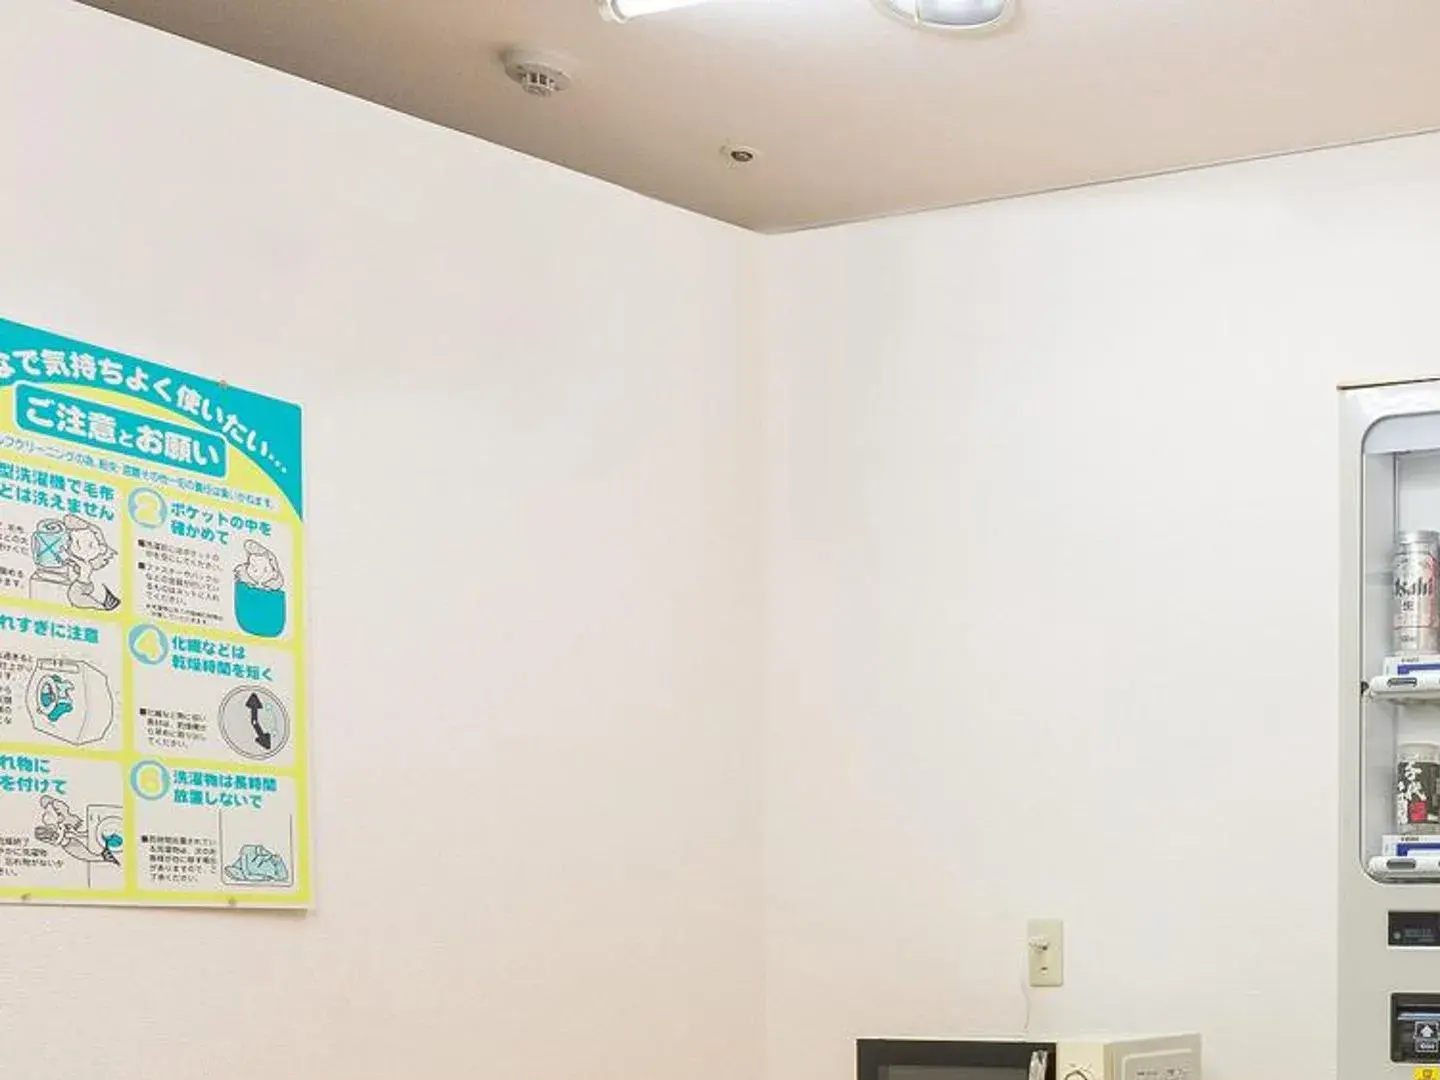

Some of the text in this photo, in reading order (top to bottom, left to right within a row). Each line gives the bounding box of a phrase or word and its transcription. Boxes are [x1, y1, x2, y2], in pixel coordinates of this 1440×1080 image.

[26, 396, 220, 465] ご注意とお願い
[170, 501, 273, 537] ポケットの中を
[170, 518, 230, 546] 確かめて
[171, 655, 274, 681] 乾燥時間を短く
[172, 768, 278, 792] 洗濯物は長時間
[173, 788, 263, 809] 放置しないで
